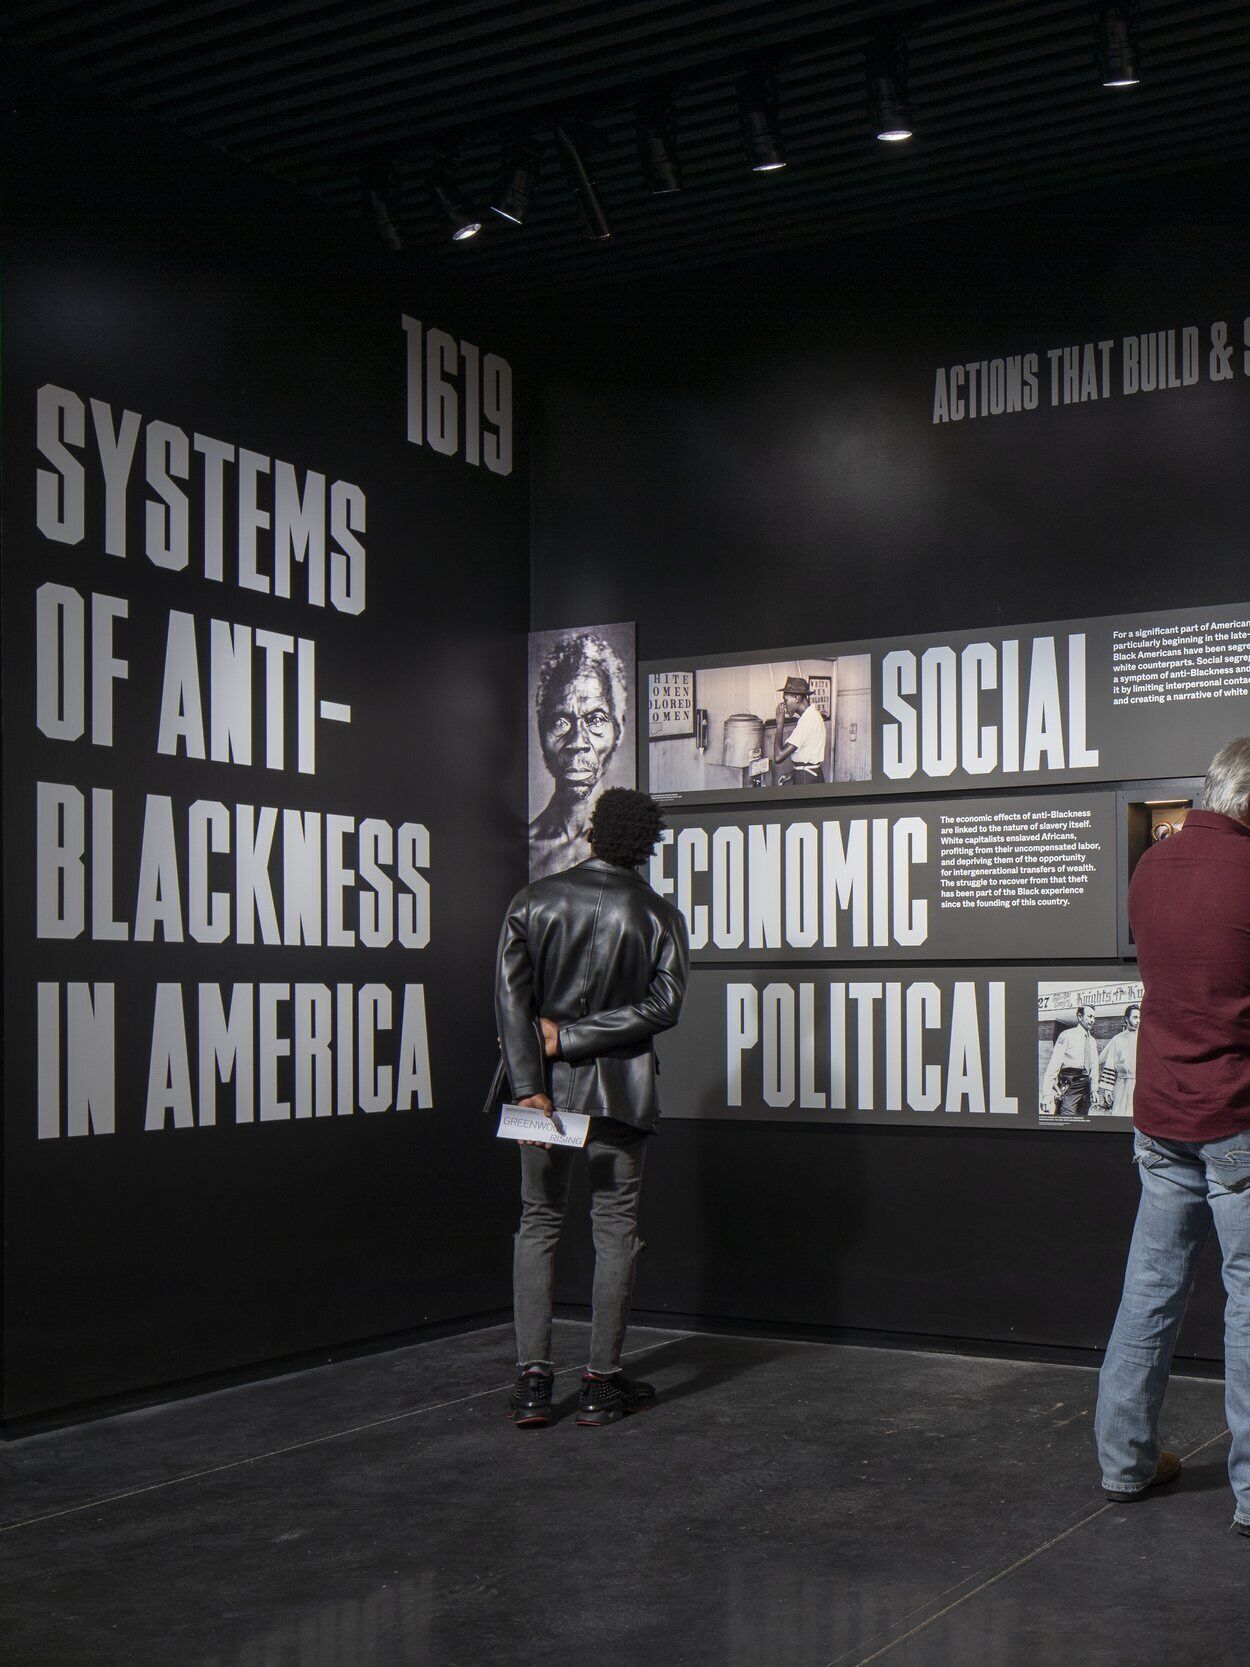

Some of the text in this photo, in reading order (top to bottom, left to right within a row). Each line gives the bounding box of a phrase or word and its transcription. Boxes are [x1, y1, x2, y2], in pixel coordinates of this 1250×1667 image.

[933, 353, 1039, 424] ACTIONS
[1048, 339, 1113, 408] THAT
[1123, 326, 1199, 396] BUILD
[1209, 322, 1234, 382] &
[402, 314, 513, 477] 1619
[36, 384, 366, 615] SYSTEMS
[1113, 630, 1127, 638] For
[1135, 626, 1179, 638] significant
[1180, 624, 1199, 635] part
[1200, 623, 1209, 631] of
[1113, 638, 1161, 650] particularly
[1162, 635, 1204, 646] beginning
[1214, 633, 1229, 641] the
[1113, 651, 1136, 660] Black
[1138, 649, 1182, 658] Americans
[1113, 662, 1136, 671] white
[1138, 658, 1195, 669] counterparts.
[1196, 655, 1223, 664] Social
[37, 582, 351, 775] OF ANTI-
[653, 674, 689, 684] HITE
[1120, 672, 1158, 683] symptom
[1160, 670, 1169, 678] of
[1170, 667, 1234, 678] anti-Blackness
[653, 687, 690, 697] OMEN
[1121, 684, 1132, 694] by
[1133, 682, 1164, 691] limiting
[1166, 677, 1222, 690] interpersonal
[1113, 695, 1129, 704] and
[1130, 694, 1165, 703] creating
[1173, 690, 1212, 700] narrative
[1213, 689, 1222, 697] of
[1224, 688, 1248, 696] white
[883, 634, 1099, 780] SOCIAL
[652, 711, 690, 722] OMEN
[956, 814, 992, 823] economic
[1032, 810, 1091, 819] anti-Blackness
[955, 825, 978, 833] linked
[1039, 822, 1068, 831] slavery
[1069, 820, 1091, 828] itself.
[965, 835, 1005, 845] capitalists
[1006, 834, 1040, 842] enslaved
[37, 781, 431, 949] BLACKNESS
[649, 817, 928, 950] ECONOMIC
[727, 981, 1018, 1114] POLITICAL
[38, 982, 433, 1140] IN AMERICA
[550, 1134, 582, 1145] RISING
